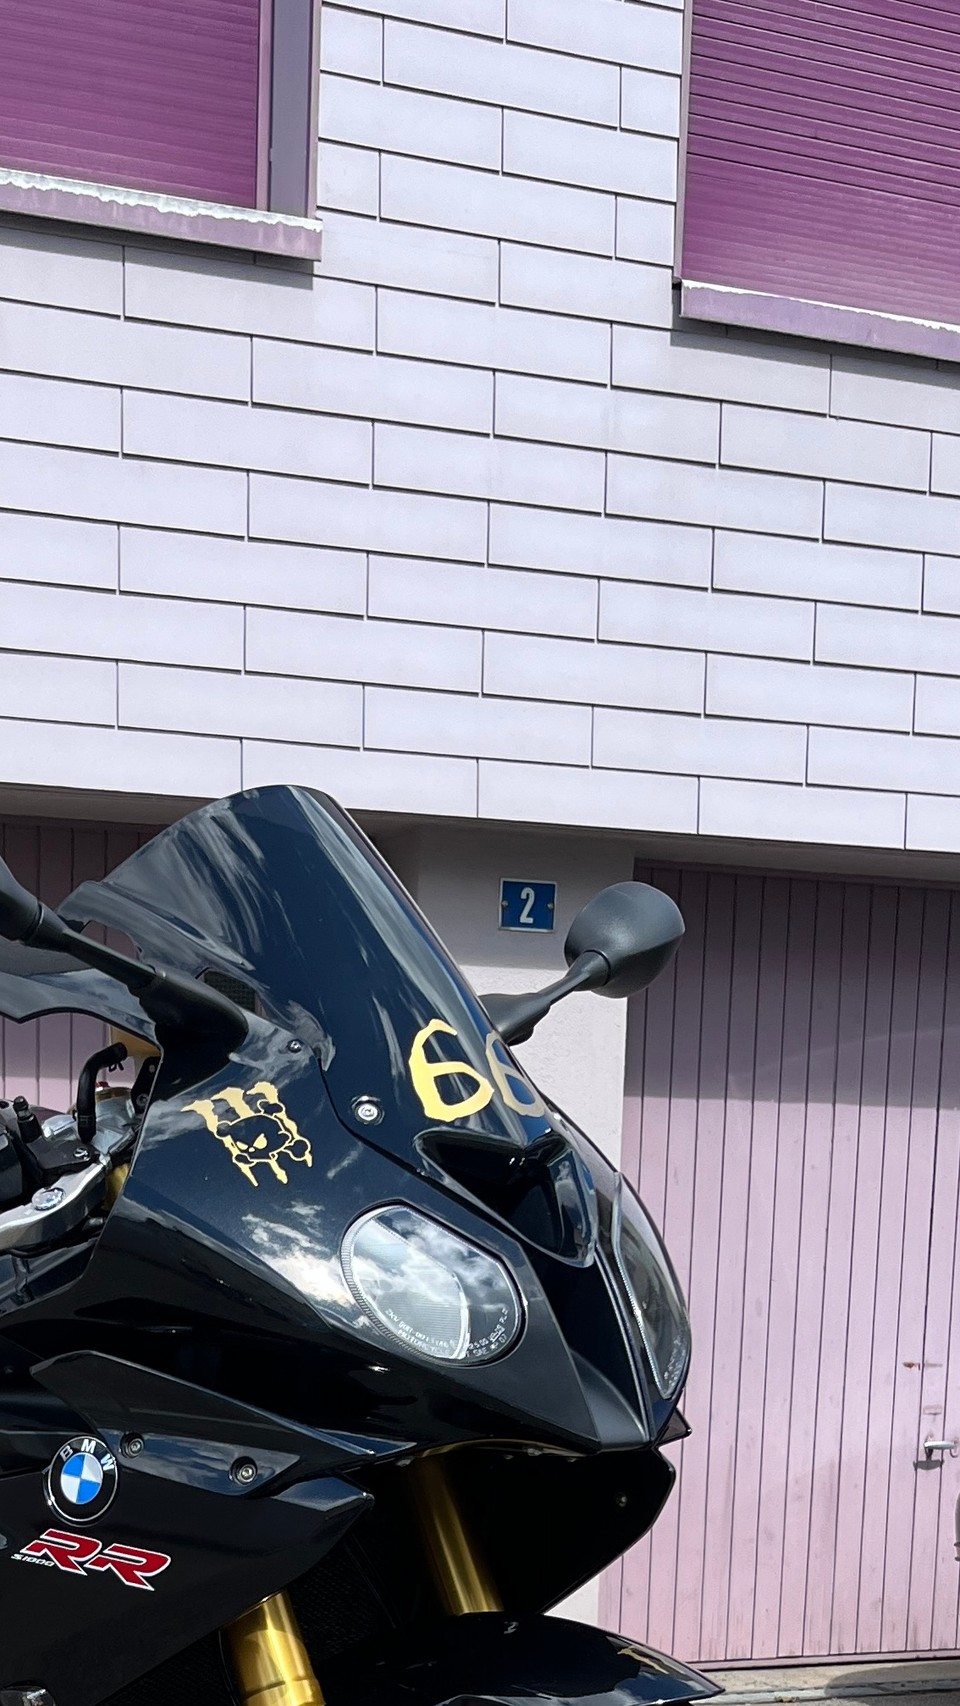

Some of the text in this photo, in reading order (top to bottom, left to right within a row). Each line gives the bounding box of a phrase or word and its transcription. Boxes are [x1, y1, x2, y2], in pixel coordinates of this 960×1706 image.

[519, 887, 536, 924] 2
[60, 1438, 116, 1472] BMW
[11, 1528, 171, 1591] S1000 RR
